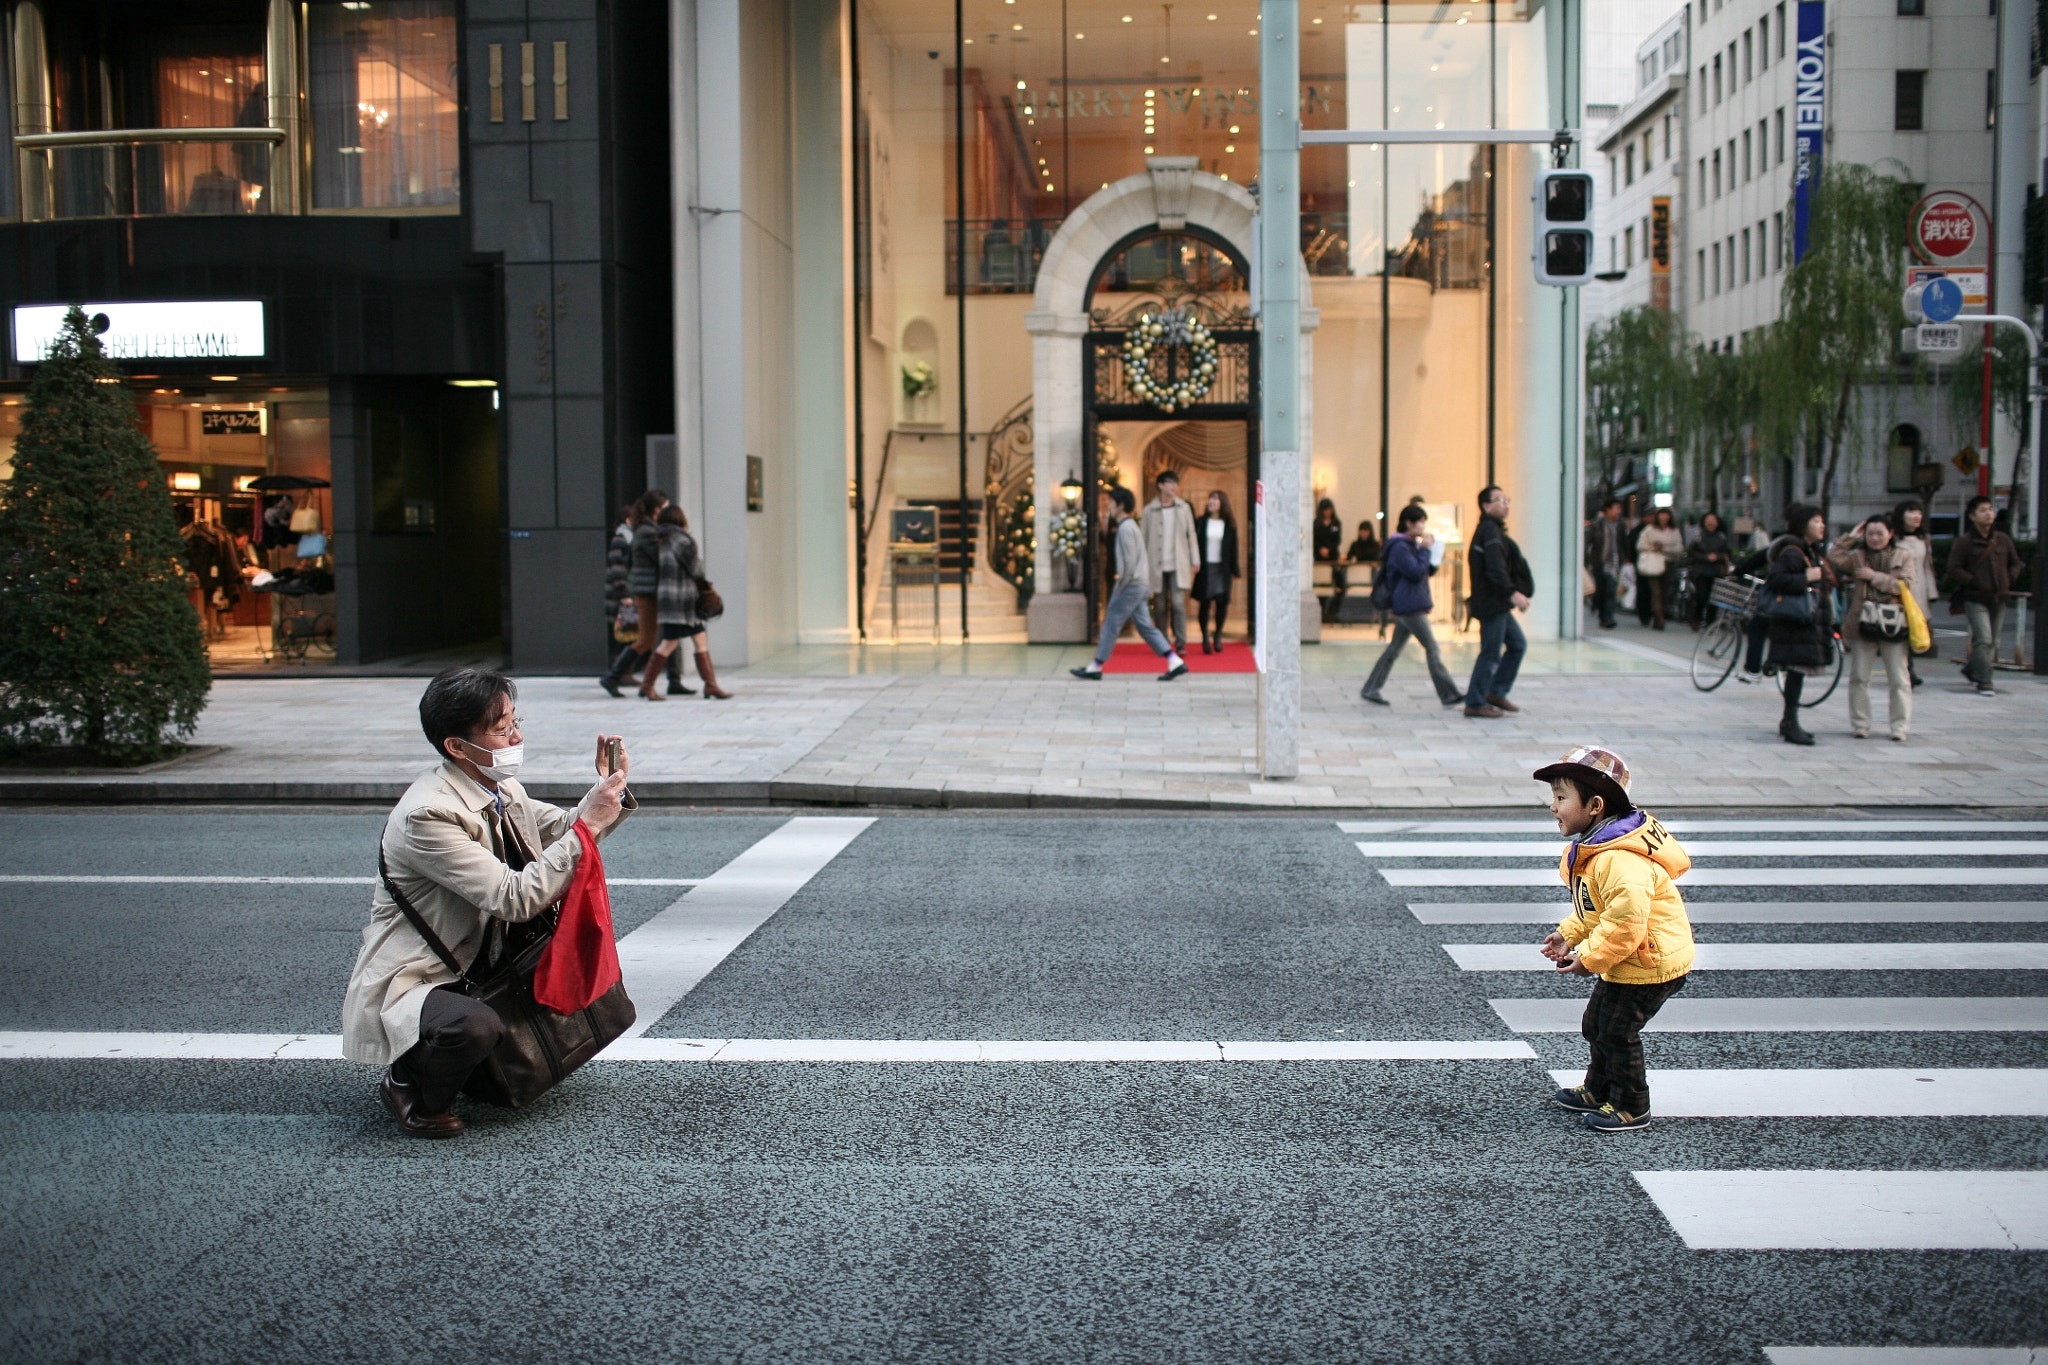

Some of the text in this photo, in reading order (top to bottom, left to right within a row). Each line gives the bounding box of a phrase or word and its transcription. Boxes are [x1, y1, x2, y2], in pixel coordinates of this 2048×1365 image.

[1797, 34, 1824, 131] YONEI
[1017, 87, 1330, 119] HARRY WINSN
[1924, 218, 1972, 241] 消火栓
